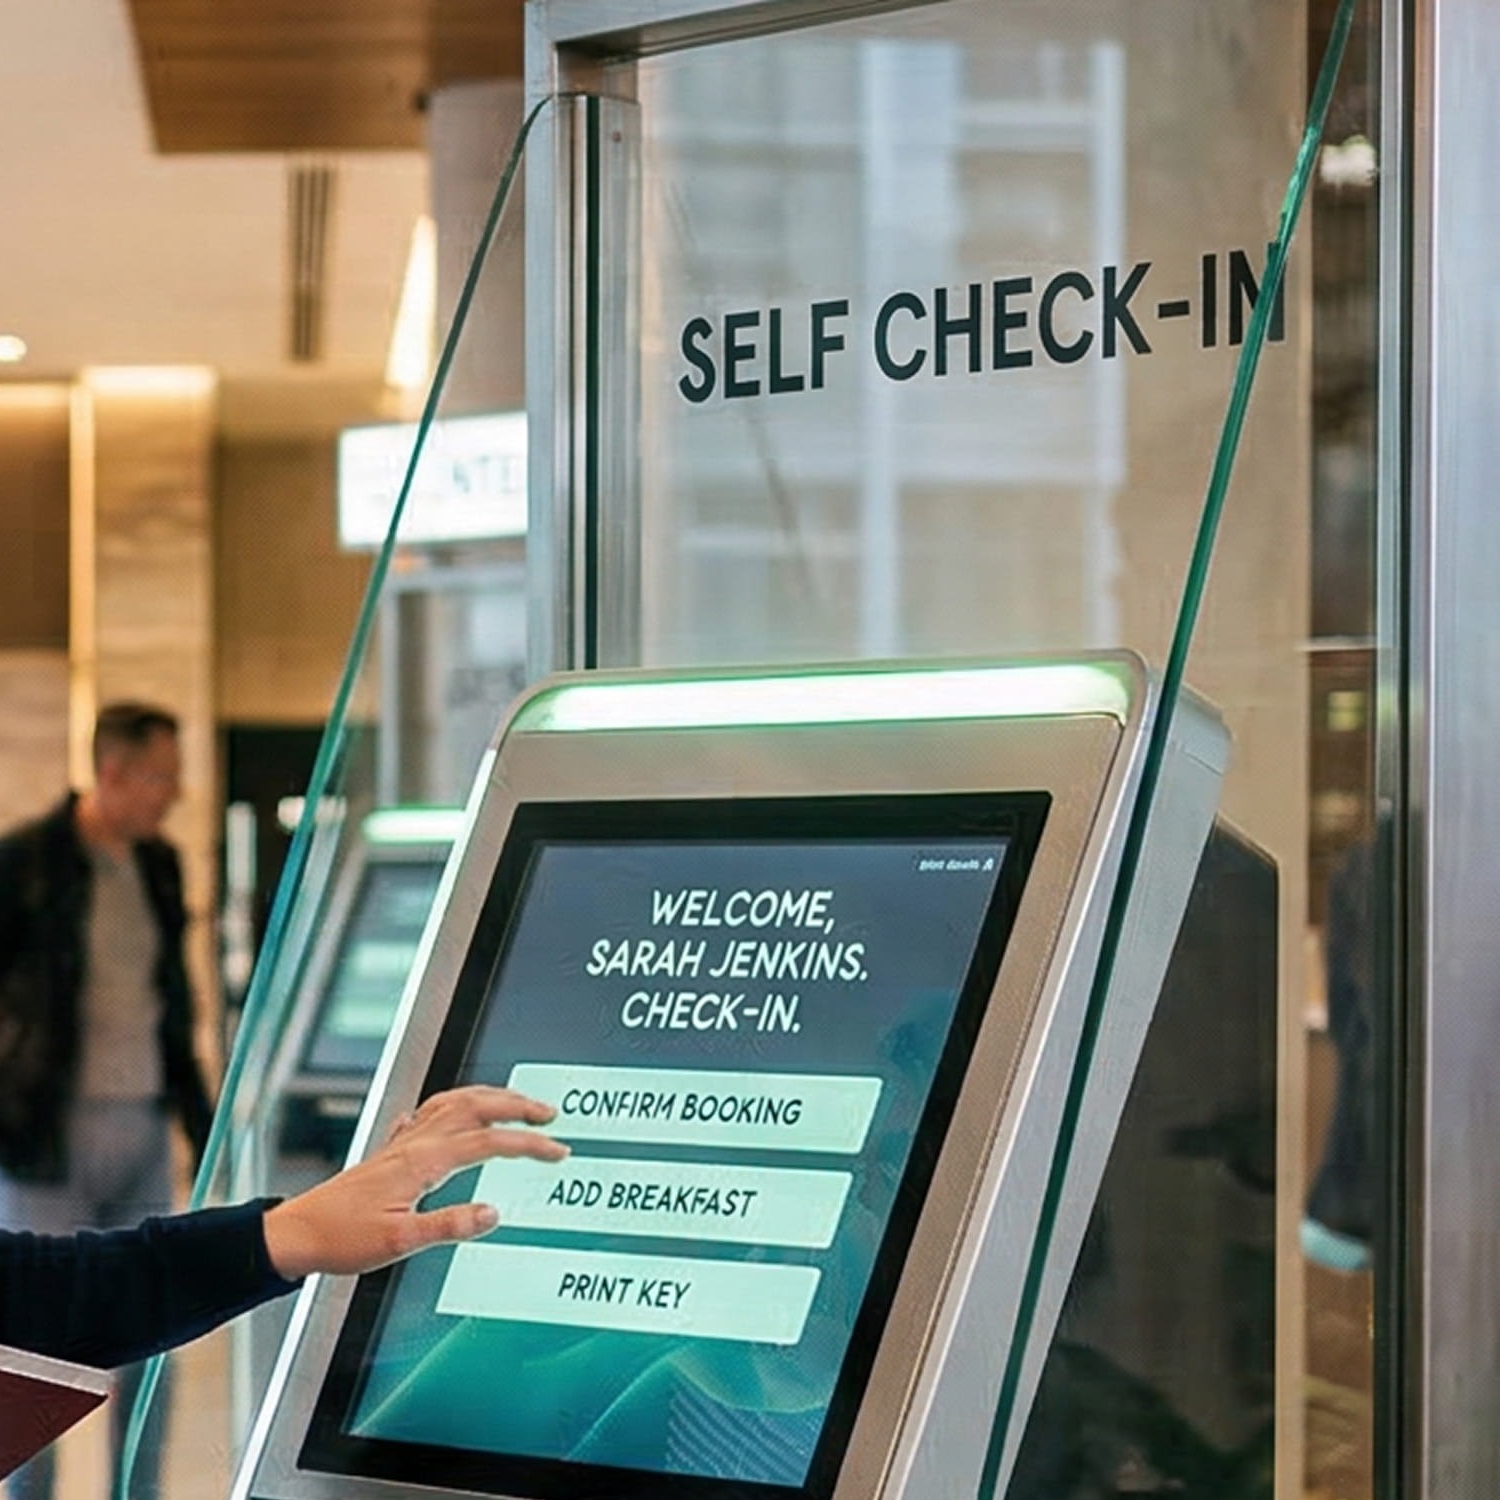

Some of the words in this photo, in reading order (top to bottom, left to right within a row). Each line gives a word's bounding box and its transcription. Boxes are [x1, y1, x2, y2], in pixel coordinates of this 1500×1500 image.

[679, 299, 849, 403] SELF
[874, 242, 1288, 381] CHECK-IN
[651, 889, 836, 934] WELCOME,
[586, 939, 706, 978] SARAH
[708, 942, 869, 981] JENKINS.
[621, 991, 802, 1034] CHECK-IN.
[561, 1088, 676, 1120] CONFIRM
[680, 1093, 803, 1126] BOOKING
[548, 1179, 602, 1207] ADD
[607, 1182, 758, 1218] BREAKFAST
[557, 1272, 633, 1304] PRINT
[637, 1279, 690, 1309] KEY
